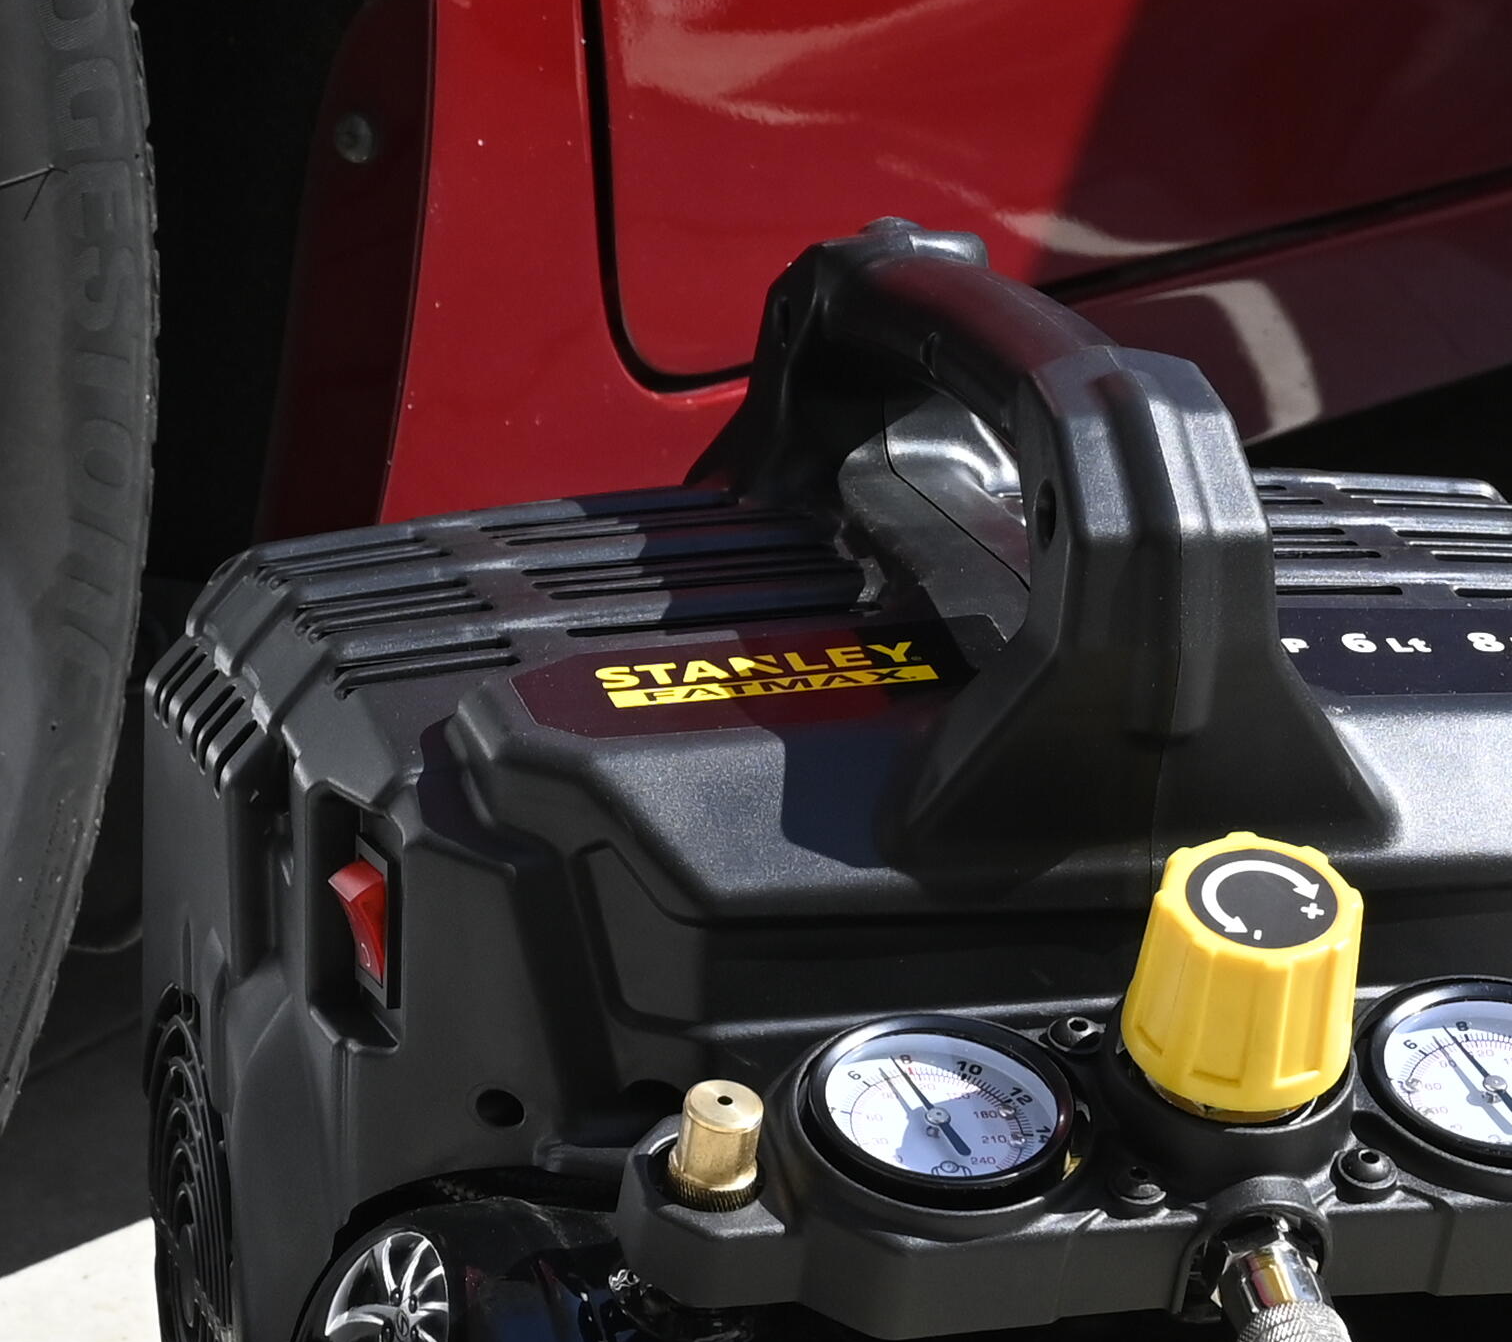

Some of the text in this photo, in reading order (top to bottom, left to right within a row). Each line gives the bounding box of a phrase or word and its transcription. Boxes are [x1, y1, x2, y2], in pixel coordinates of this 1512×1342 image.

[1280, 637, 1309, 653] P
[1341, 632, 1377, 653] 6
[1386, 637, 1432, 653] Lt
[1467, 632, 1505, 653] 8
[595, 641, 913, 689] STANLEY
[645, 670, 912, 702] FATMAX
[1456, 1021, 1469, 1032] 8
[1403, 1039, 1418, 1050] 6
[956, 1060, 983, 1076] 10
[847, 1070, 862, 1081] 6
[1010, 1087, 1033, 1105] 12
[973, 1110, 997, 1119] 180
[981, 1135, 1007, 1144] 210
[1036, 1125, 1052, 1144] 14
[970, 1157, 997, 1165] 240
